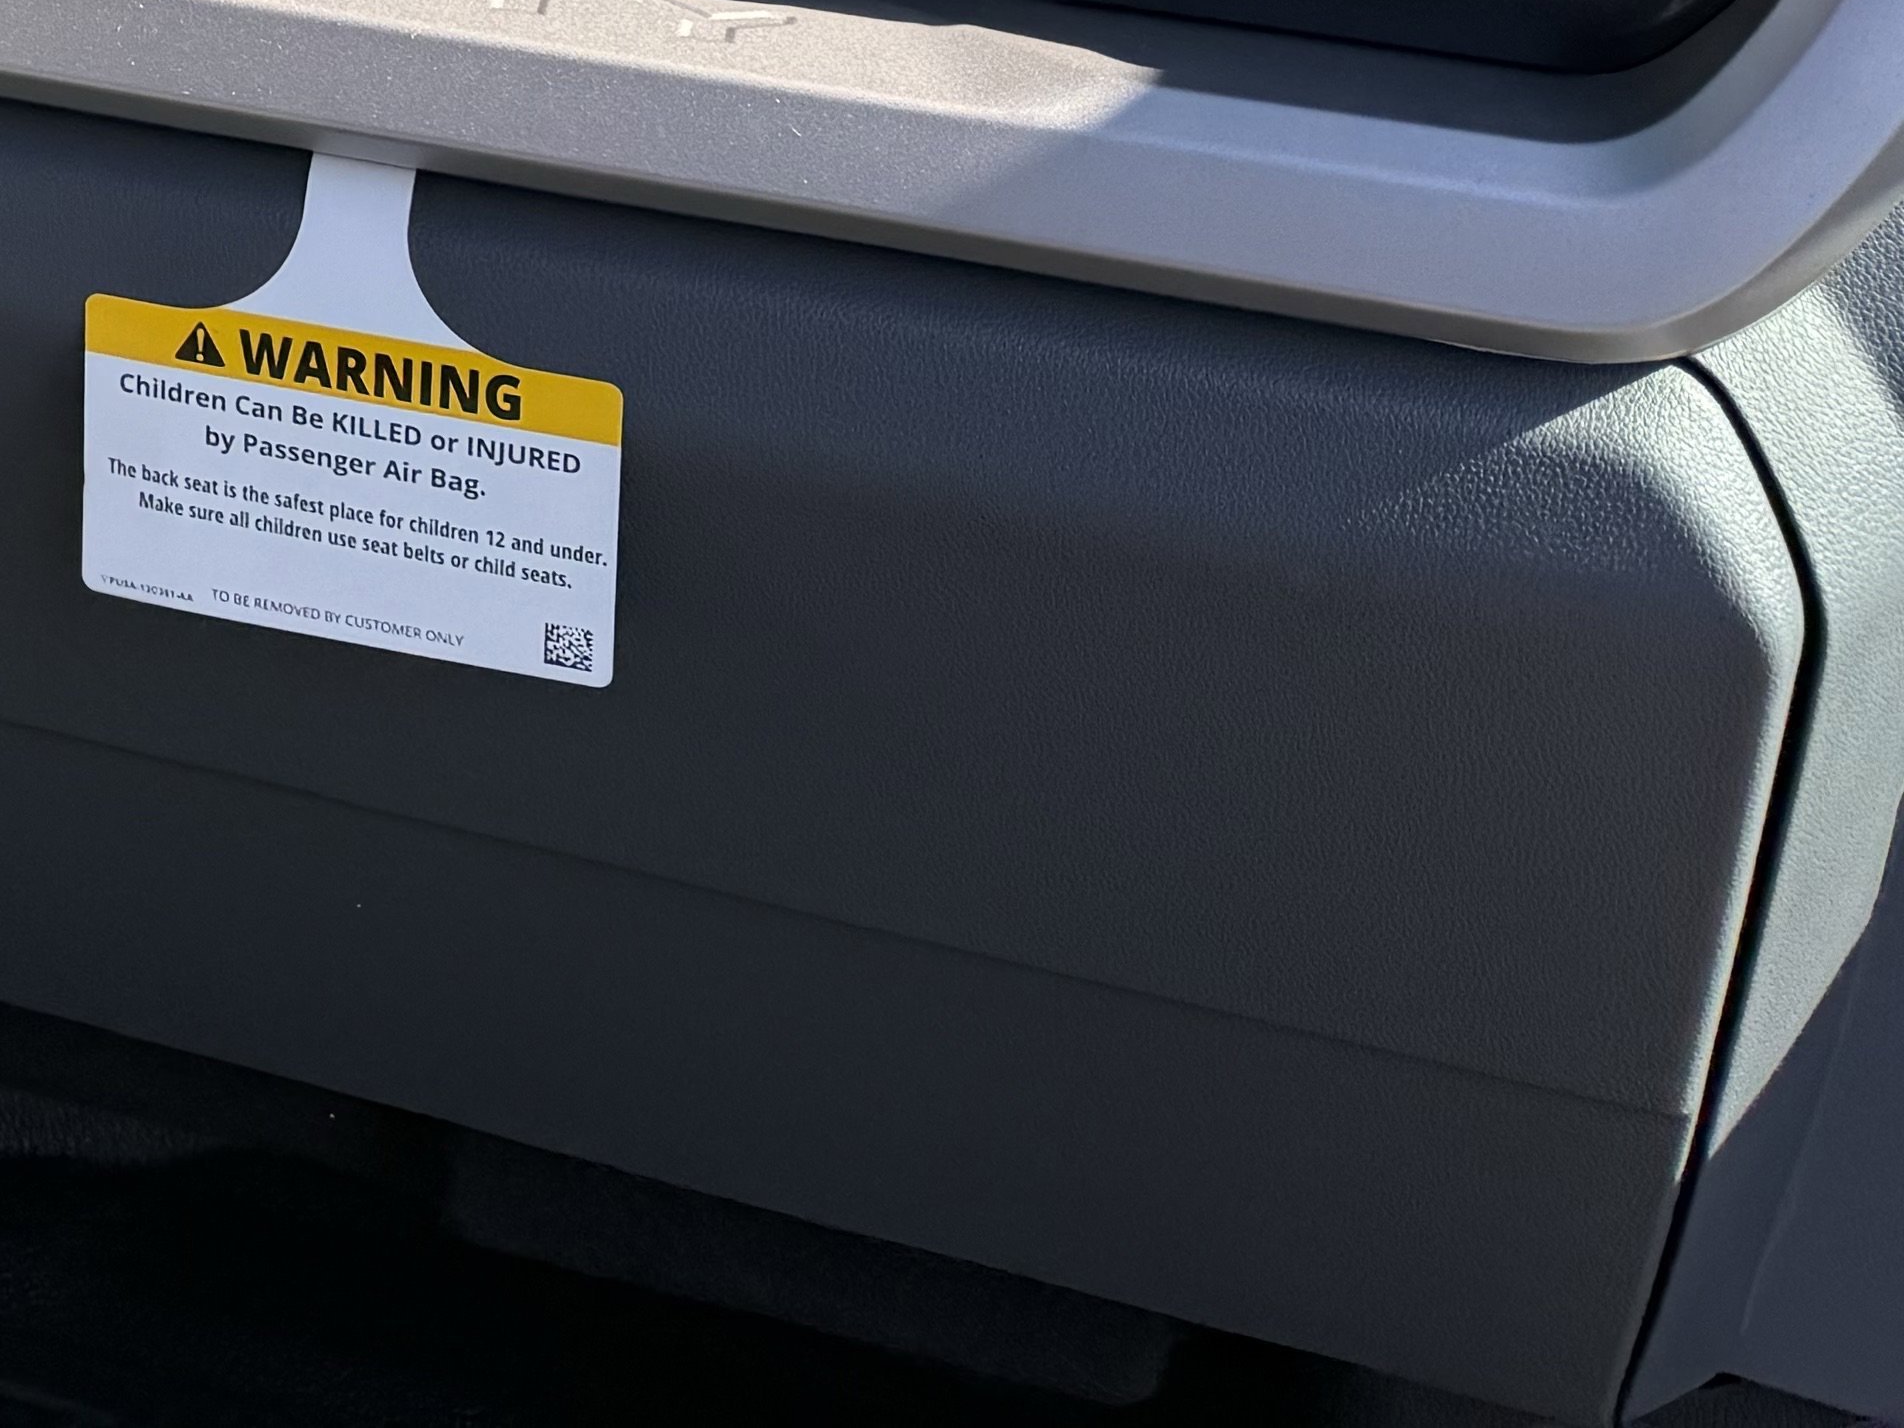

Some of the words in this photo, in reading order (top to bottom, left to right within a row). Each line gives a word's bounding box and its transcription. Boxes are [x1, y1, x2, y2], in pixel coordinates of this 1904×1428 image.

[239, 328, 522, 421] WARNING
[119, 372, 226, 412] Children
[235, 395, 282, 422] Can
[292, 404, 324, 429] Be
[332, 412, 421, 446] KILLED
[430, 434, 459, 453] or
[467, 436, 581, 474] INJURED
[205, 424, 235, 455] by
[244, 433, 377, 476] Passenger
[383, 459, 422, 484] Air
[431, 467, 486, 500] Bag.
[108, 457, 136, 478] The
[142, 464, 179, 488] back
[184, 476, 218, 496] seat
[223, 480, 237, 498] is
[242, 485, 269, 505] the
[274, 493, 324, 516] safest
[329, 502, 373, 524] place
[379, 509, 404, 530] for
[409, 516, 479, 544] children
[486, 529, 505, 548] 12
[511, 535, 544, 555] and
[550, 541, 608, 567] under.
[138, 491, 184, 516] Make
[189, 505, 224, 524] sure
[229, 510, 250, 529] all
[255, 514, 323, 543] children
[328, 530, 357, 549] use
[362, 537, 398, 557] seat
[404, 541, 445, 566] belts
[451, 553, 469, 569] or
[474, 555, 516, 578] child
[521, 566, 572, 590] seats.
[212, 587, 229, 603] TO
[234, 592, 250, 608] BE
[253, 597, 321, 620] REMOVED
[324, 611, 341, 624] BY
[345, 615, 422, 640] CUSTOMER
[426, 630, 464, 647] ONLY
